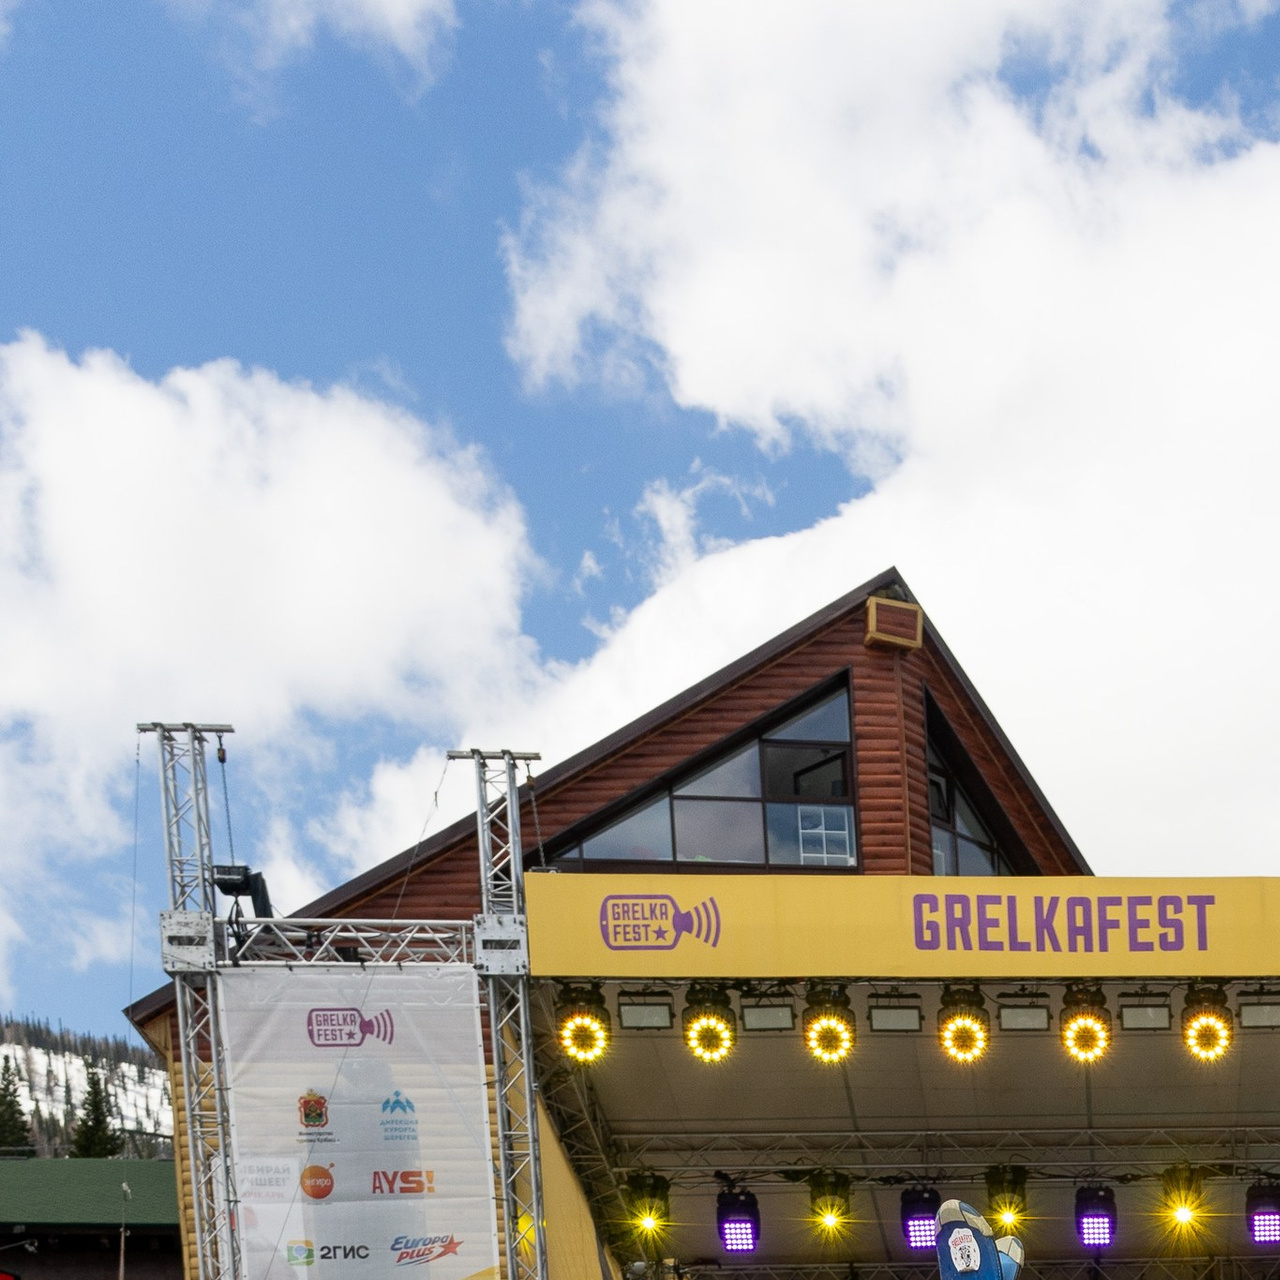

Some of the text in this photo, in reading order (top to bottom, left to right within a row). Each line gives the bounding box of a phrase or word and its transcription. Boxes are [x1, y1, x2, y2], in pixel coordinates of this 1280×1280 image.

[611, 902, 669, 921] GRELKA
[913, 894, 1215, 953] GRELKAFEST
[613, 924, 650, 942] FEST
[315, 1013, 358, 1027] GRELKA
[316, 1028, 344, 1042] FEST
[372, 1169, 436, 1194] AYS!
[320, 1244, 370, 1259] 2ГИС
